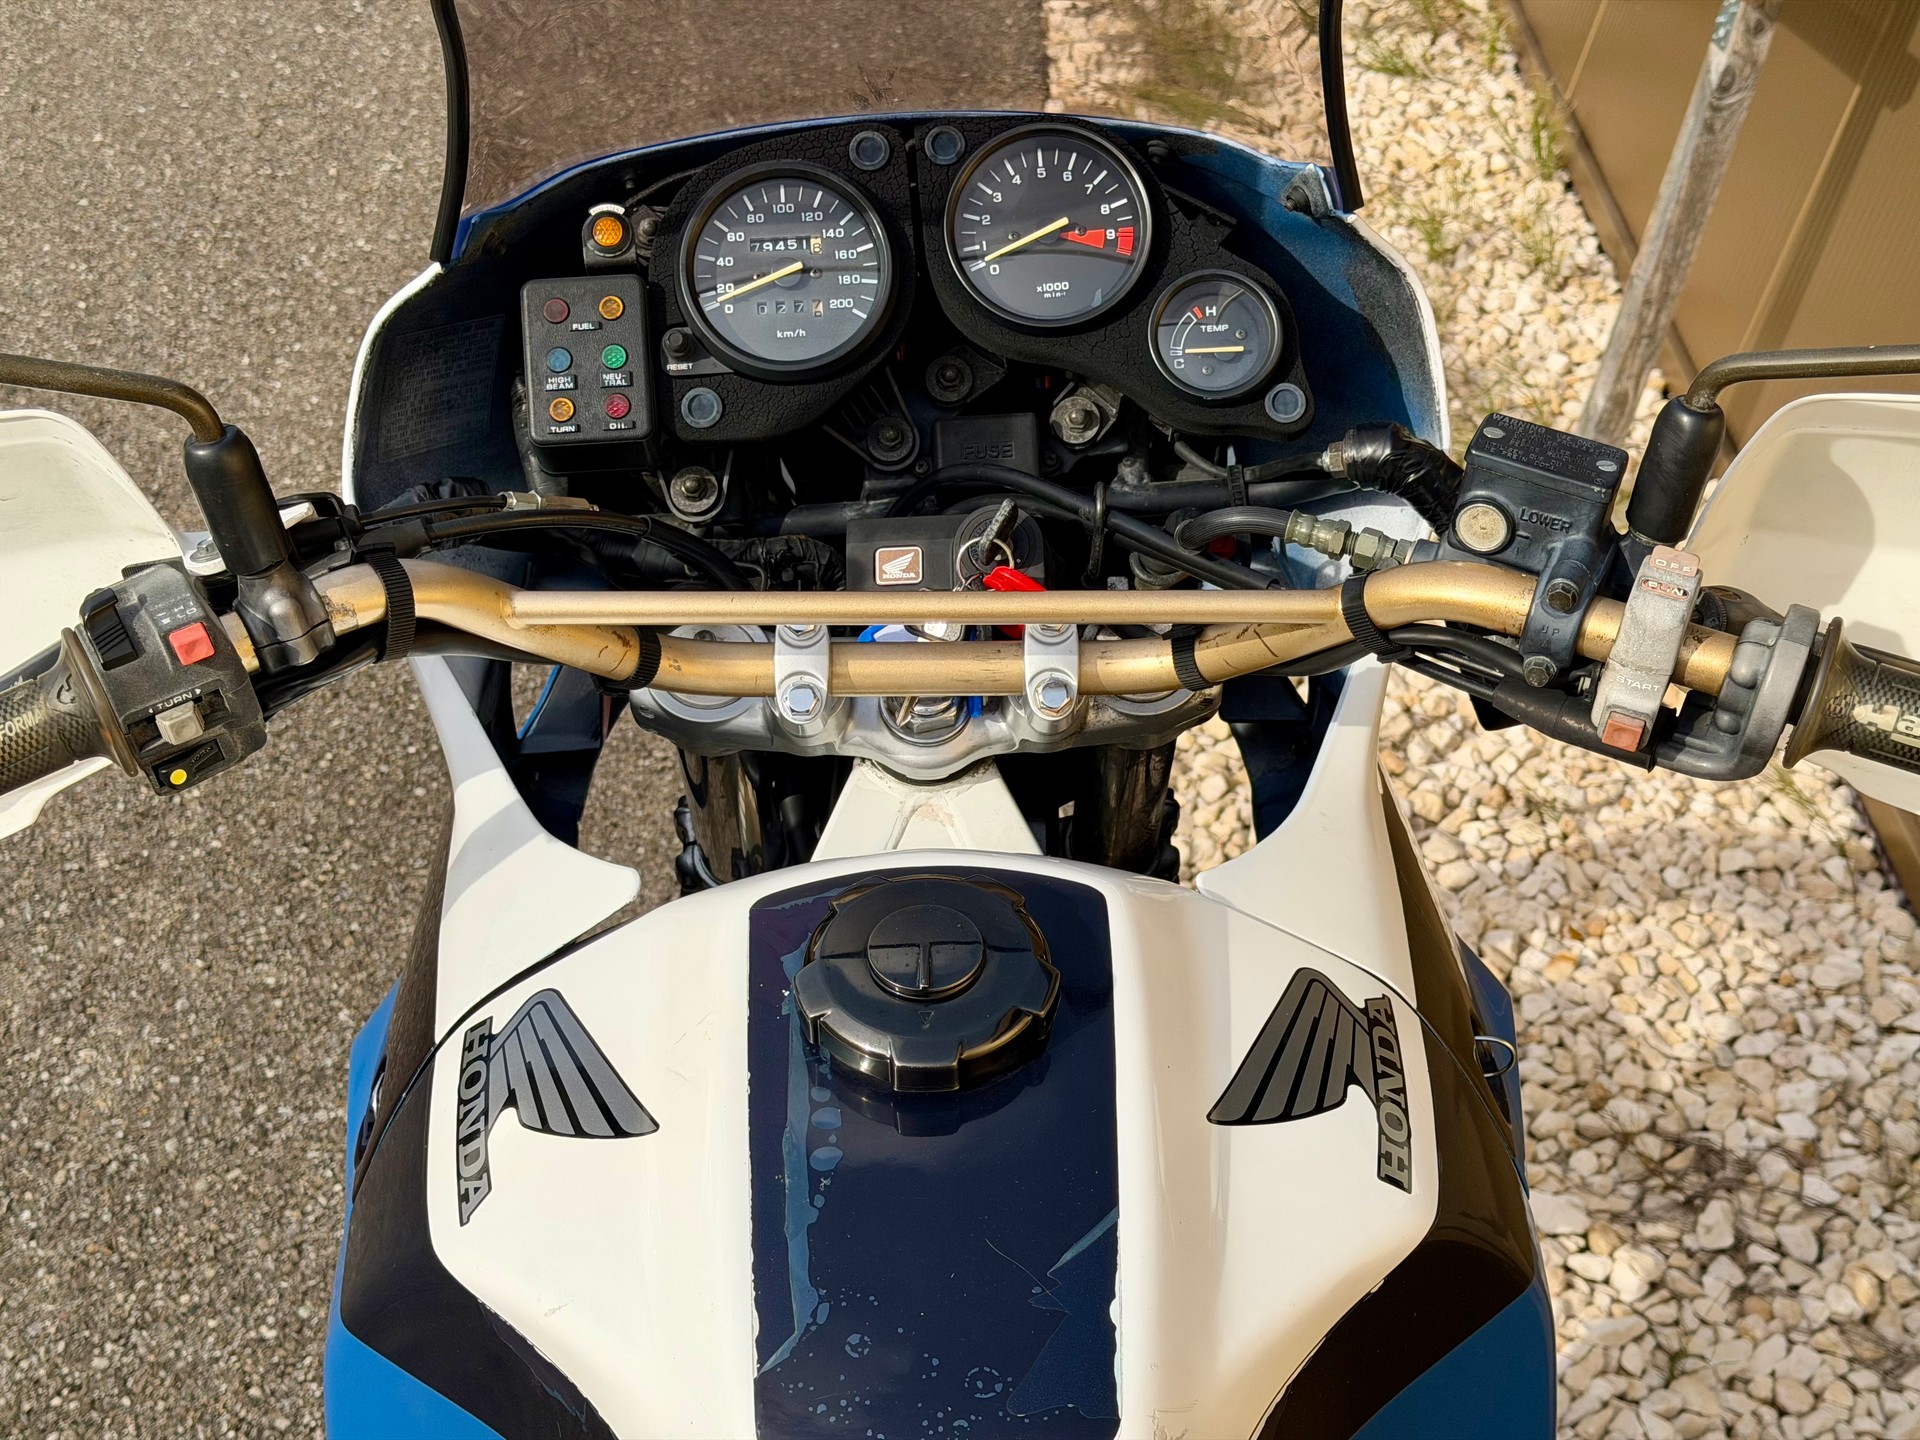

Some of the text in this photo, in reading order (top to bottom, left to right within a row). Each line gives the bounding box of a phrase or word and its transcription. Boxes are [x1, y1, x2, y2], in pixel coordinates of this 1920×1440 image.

[1037, 168, 1046, 178] 5
[1063, 171, 1072, 181] 6
[1012, 175, 1022, 185] 4
[1084, 184, 1094, 195] 7
[993, 192, 1002, 202] 3
[772, 203, 795, 214] 100
[1100, 204, 1110, 215] 8
[746, 213, 764, 223] 80
[801, 211, 824, 222] 120
[981, 215, 991, 225] 2
[727, 232, 745, 242] 60
[822, 228, 845, 239] 140
[1106, 229, 1116, 240] 9
[981, 241, 987, 251] 1
[834, 250, 857, 260] 160
[716, 257, 734, 267] 40
[989, 264, 1000, 275] 0
[838, 275, 861, 285] 180
[716, 283, 735, 294] 20
[1036, 281, 1069, 293] x1000
[724, 303, 734, 314] 0
[829, 298, 854, 309] 200
[1205, 305, 1217, 317] H
[572, 323, 595, 331] FUEL
[1200, 324, 1229, 333] TEMP
[776, 328, 806, 339] km/h
[666, 363, 693, 371] RESET
[1174, 359, 1185, 369] C
[546, 382, 574, 390] BEAM
[609, 422, 627, 430] OIL
[1492, 413, 1545, 433] WARNING
[550, 425, 576, 433] TURN
[963, 442, 1014, 460] FUSE
[1519, 506, 1574, 535] LOWER
[1655, 558, 1692, 574] OFF
[882, 571, 917, 579] HONDA
[1616, 675, 1661, 692] START
[156, 691, 193, 711] TURN
[1368, 998, 1410, 1190] HONDA
[459, 1016, 492, 1225] HONDA
